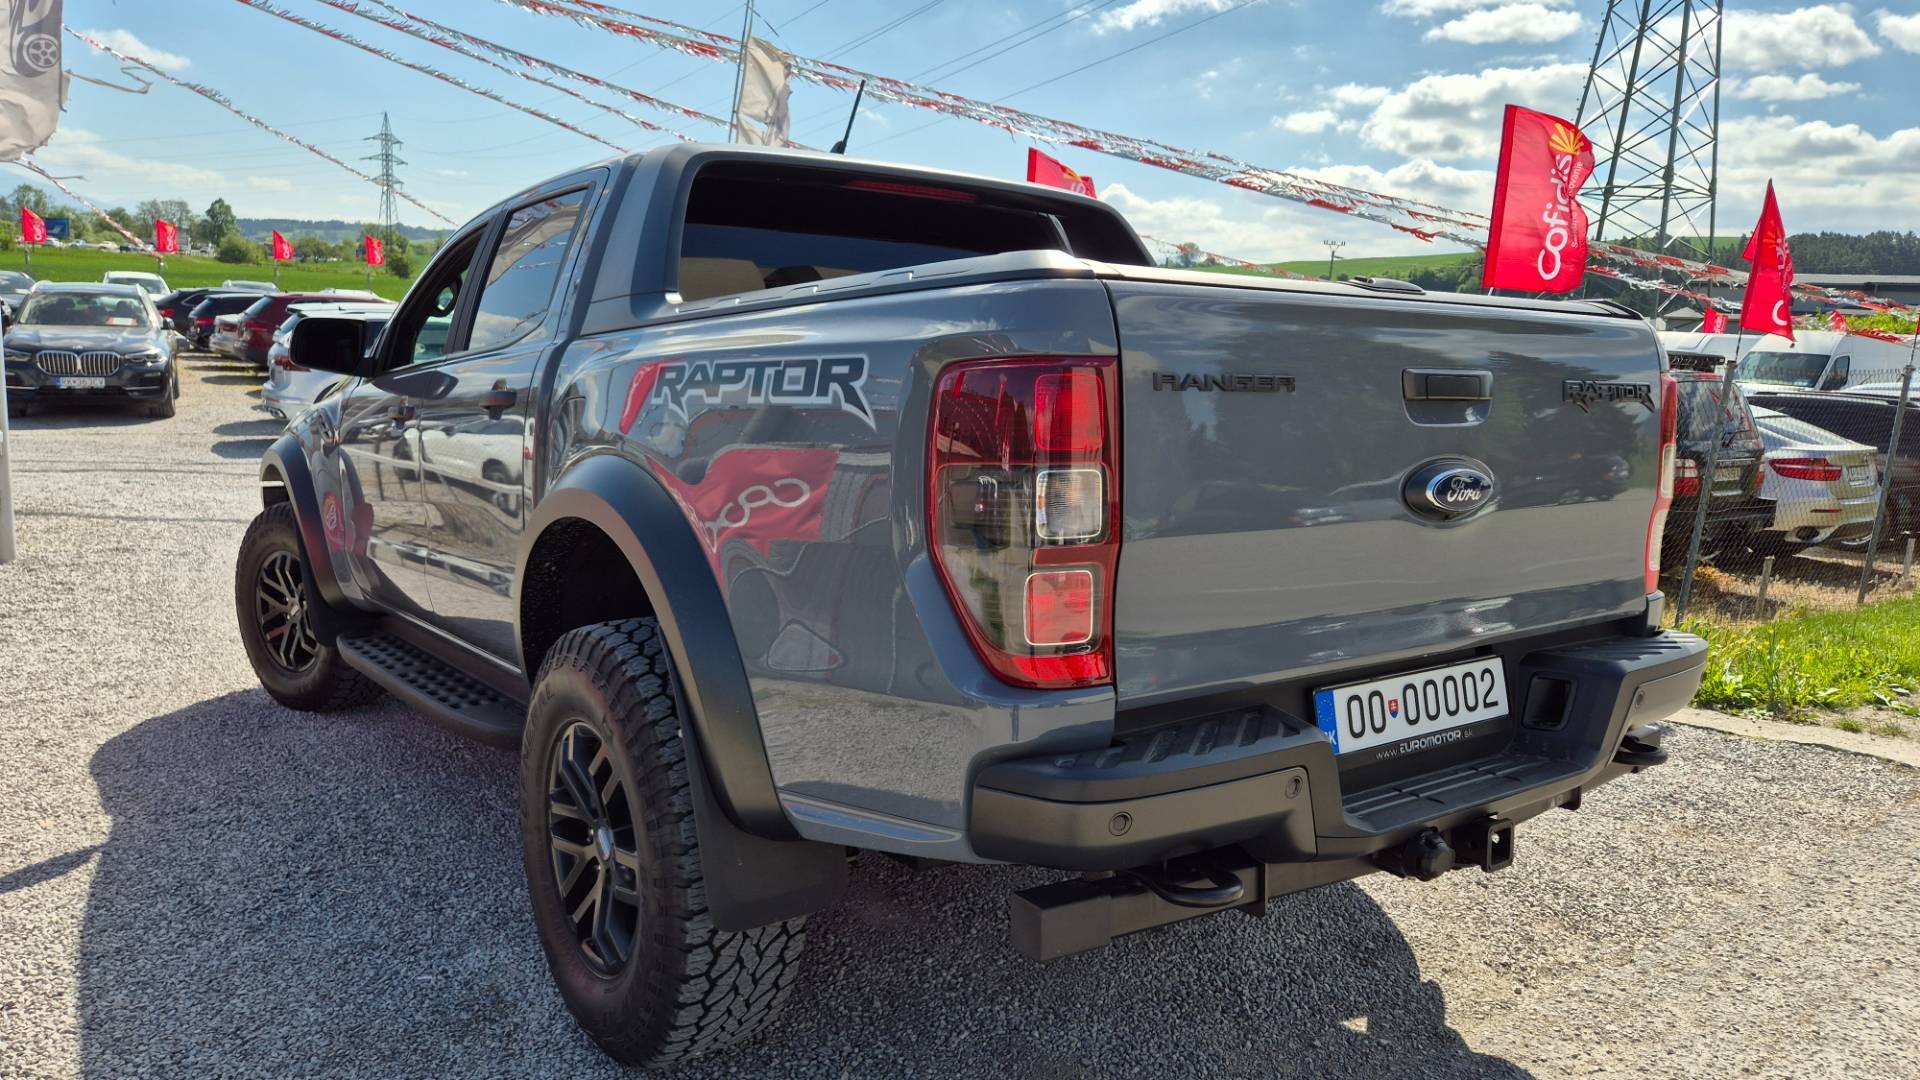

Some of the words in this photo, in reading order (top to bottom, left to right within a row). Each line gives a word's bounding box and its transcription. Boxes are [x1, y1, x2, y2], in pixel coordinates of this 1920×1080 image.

[1537, 154, 1573, 281] Cofidis
[650, 353, 877, 432] RAPTOR
[1152, 371, 1296, 393] RANGER
[1561, 379, 1655, 414] RAPTOR
[1447, 475, 1483, 502] Ford
